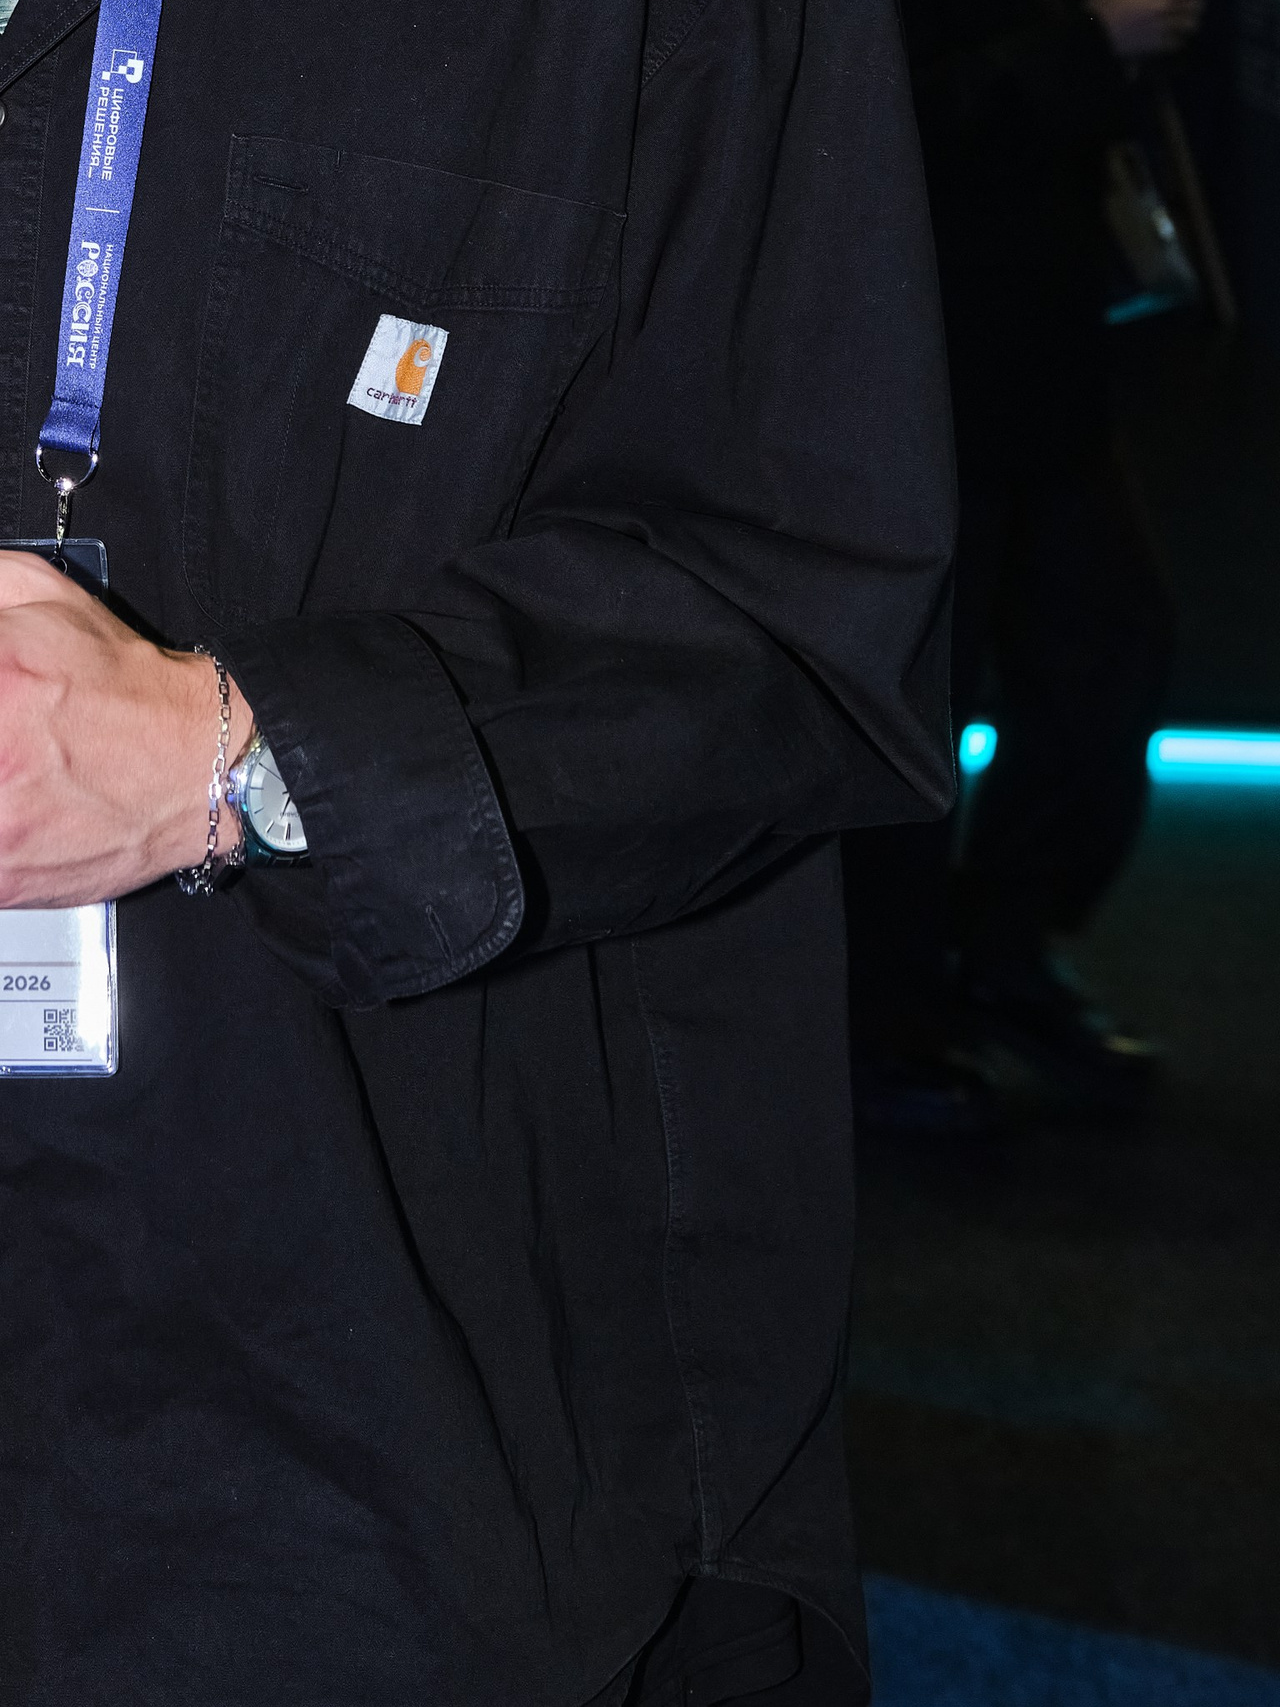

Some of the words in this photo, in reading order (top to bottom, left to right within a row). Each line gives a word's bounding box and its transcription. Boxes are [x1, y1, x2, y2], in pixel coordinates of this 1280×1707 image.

[101, 88, 124, 181] ЦИФРОВЫЕ
[66, 240, 101, 368] РОССИЯ
[94, 244, 114, 334] НАЦИОНАЛЬНЫЙ
[88, 334, 100, 370] ЦЕНТР
[3, 974, 51, 991] 2026
